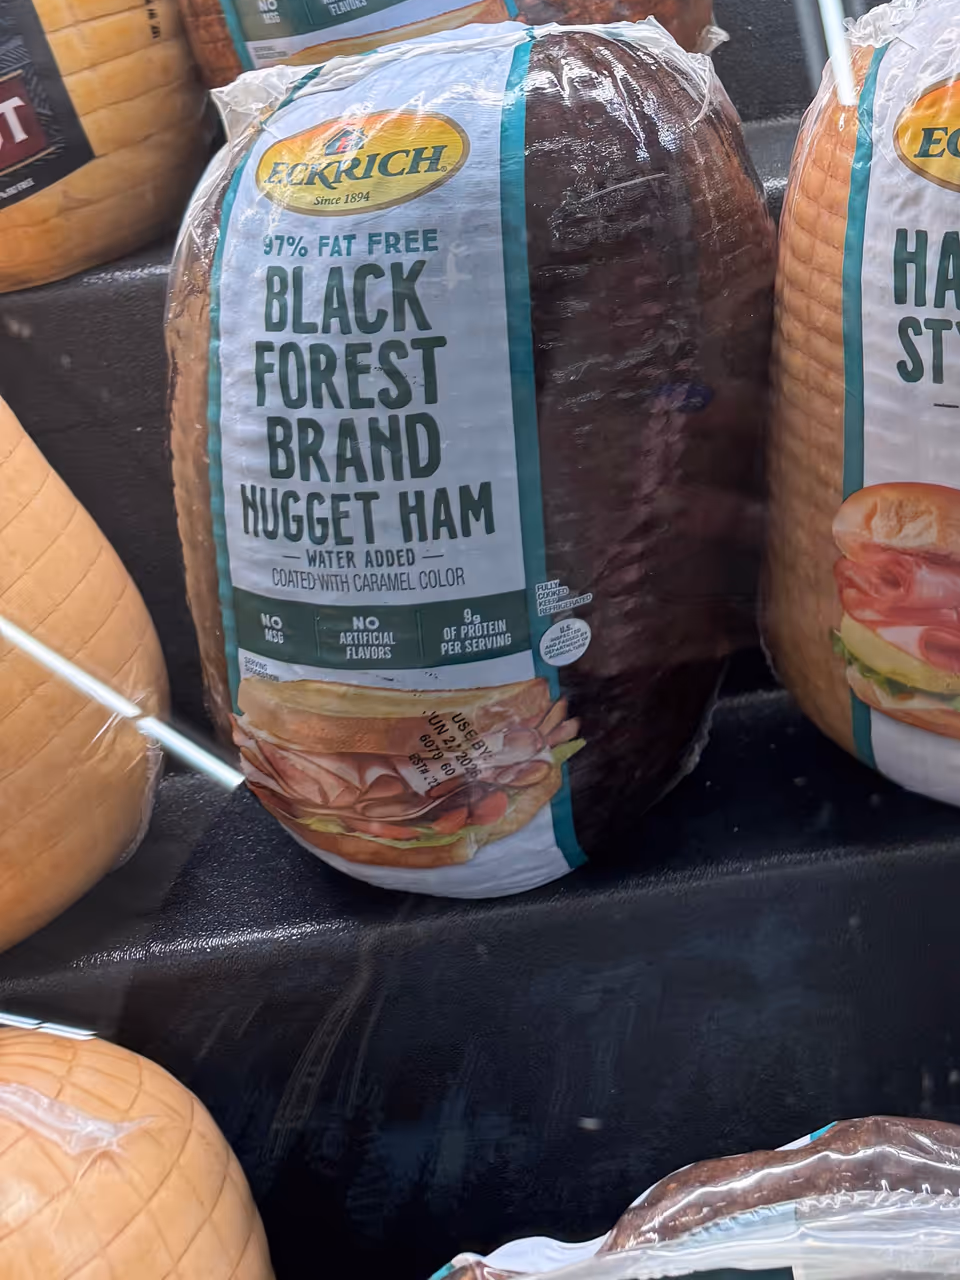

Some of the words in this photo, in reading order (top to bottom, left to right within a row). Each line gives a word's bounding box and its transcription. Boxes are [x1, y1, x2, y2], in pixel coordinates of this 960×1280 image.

[263, 144, 448, 190] ECKRICH
[313, 193, 341, 206] Since
[343, 191, 371, 204] 1894
[263, 233, 308, 258] 97%
[318, 233, 357, 257] FAT
[368, 228, 438, 254] FREE
[265, 259, 432, 335] BLACK
[254, 336, 447, 410] FOREST
[266, 412, 441, 483] BRAND
[240, 483, 380, 546] NUGGET
[399, 481, 496, 543] HAM
[306, 549, 356, 569] WATER
[365, 548, 415, 568] ADDED
[272, 568, 316, 590] COATED
[317, 573, 350, 592] WITH
[353, 572, 416, 592] CARAMEL
[419, 567, 465, 590] COLOR
[537, 581, 559, 593] FULLY
[538, 588, 568, 600] COOKED
[538, 597, 558, 608] KEEP
[540, 594, 591, 615] REFRIGERATED
[261, 613, 283, 630] NO
[352, 616, 379, 630] NO
[463, 608, 481, 624] 9g
[265, 628, 284, 644] MSG
[339, 632, 396, 645] ARTIFICIAL
[443, 627, 457, 640] OF
[460, 619, 507, 639] PROTEIN
[346, 646, 392, 660] FLAVORS
[441, 640, 462, 655] PER
[465, 633, 512, 652] SERVING
[452, 712, 478, 740] USE
